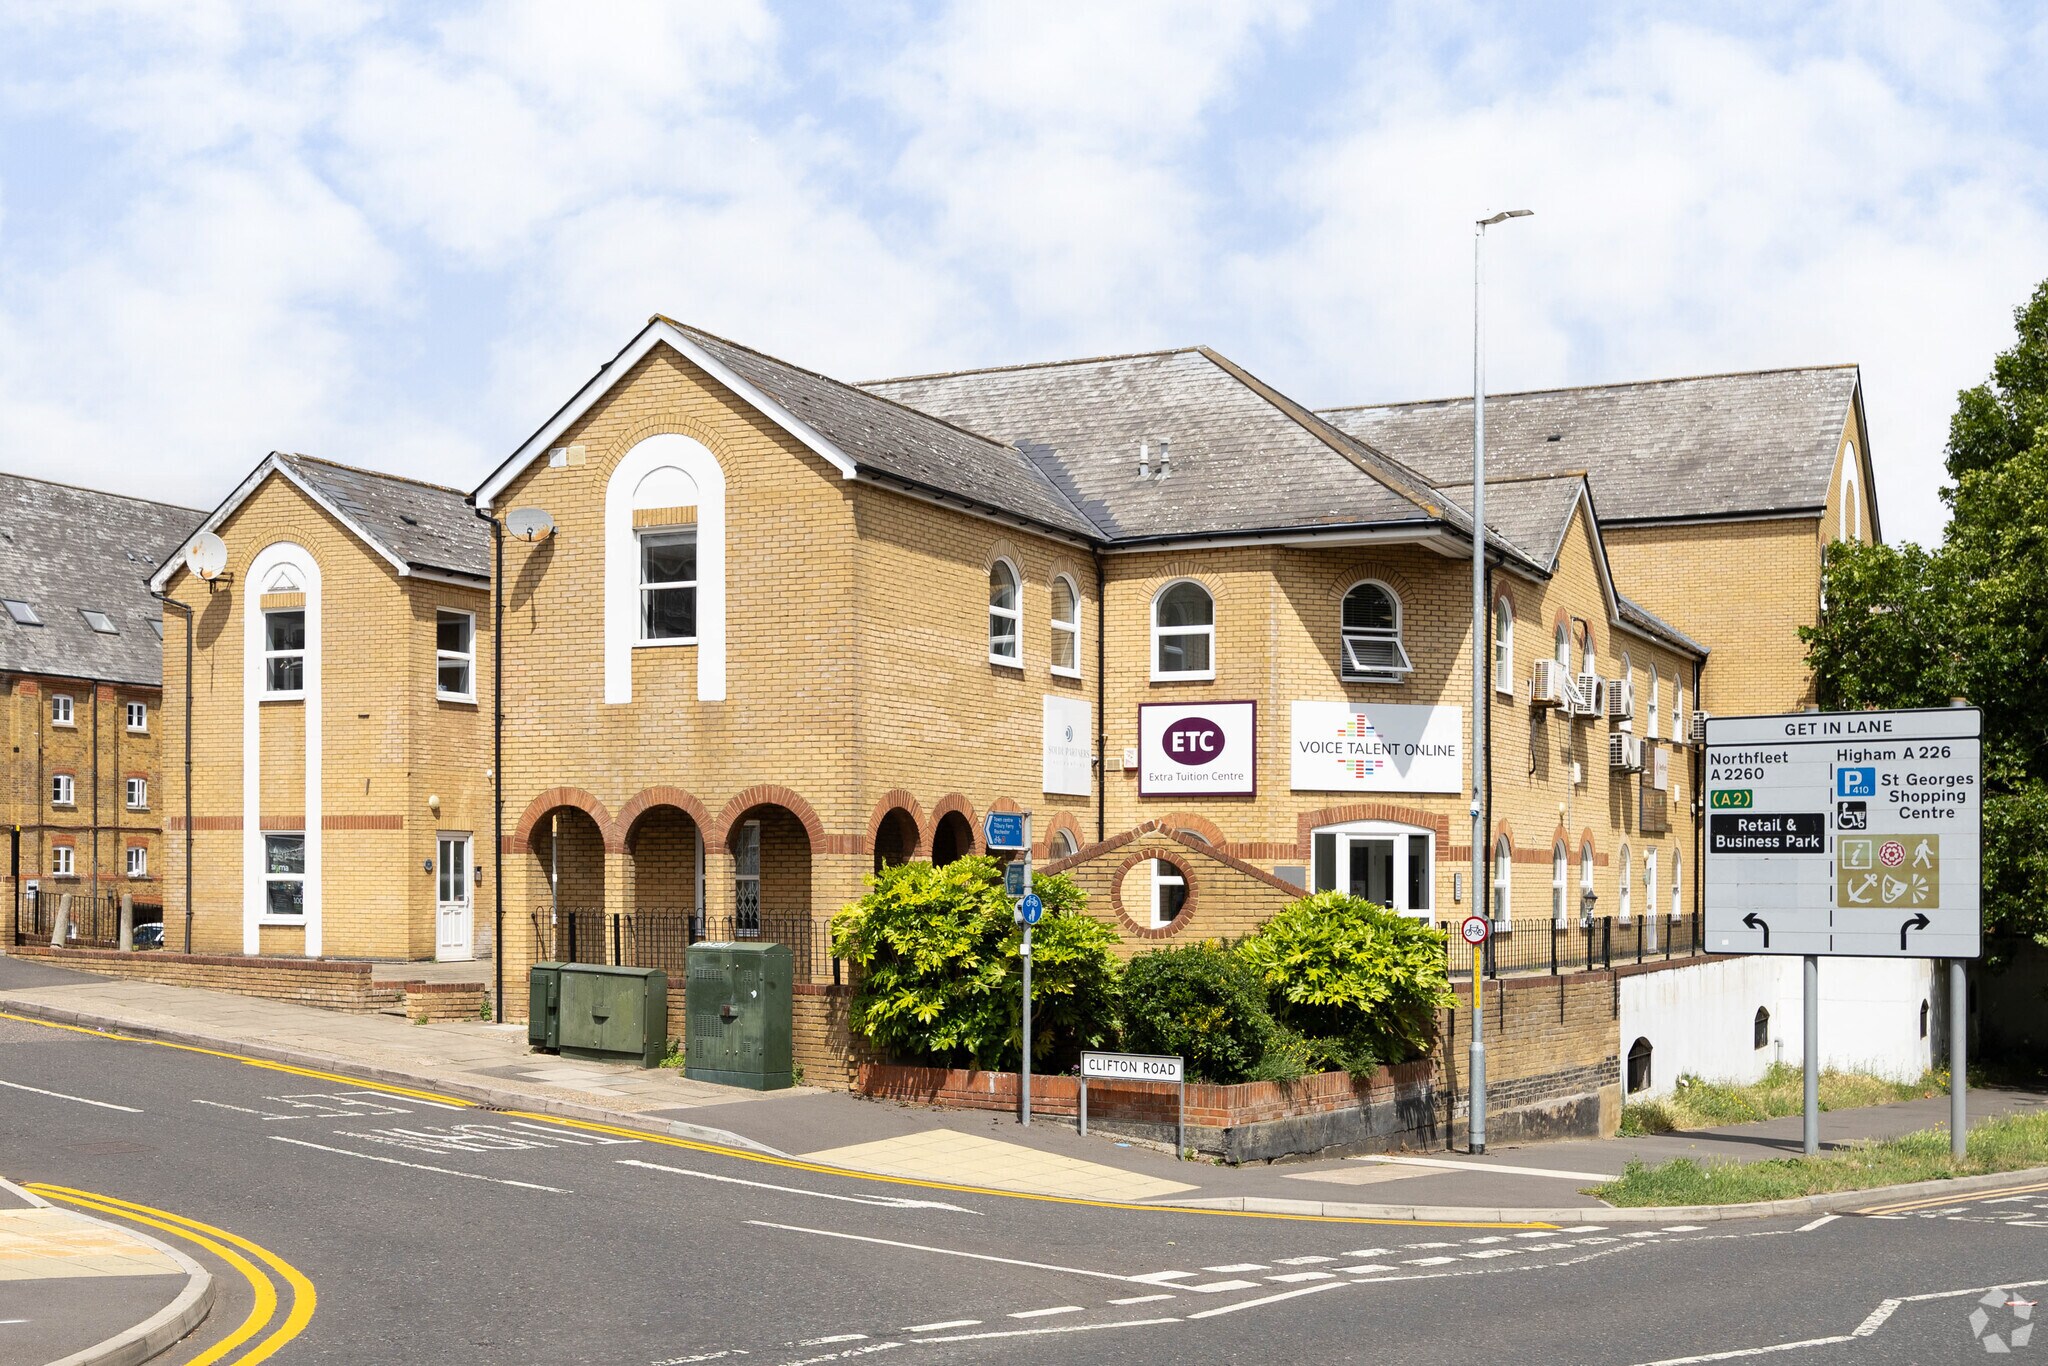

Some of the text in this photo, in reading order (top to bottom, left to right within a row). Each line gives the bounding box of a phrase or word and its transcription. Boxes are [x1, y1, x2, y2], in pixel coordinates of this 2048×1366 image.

[1785, 720, 1893, 736] GET IN LANE
[1172, 730, 1215, 752] ETC
[1299, 741, 1456, 757] VOICE TALENT ONLINE
[1837, 748, 1896, 763] Higham
[1710, 751, 1788, 765] Northfleet
[1149, 771, 1244, 782] Extra Tuition Centre
[1844, 770, 1863, 794] P
[1881, 773, 1974, 789] St Georges
[1852, 786, 1869, 795] 410
[1889, 790, 1966, 805] Shopping
[1712, 790, 1751, 808] (A2)
[1899, 806, 1955, 820] Centre
[1738, 818, 1797, 832] Retail &
[1716, 834, 1820, 849] Business Park
[1088, 1059, 1176, 1076] CLIFTON ROAD
